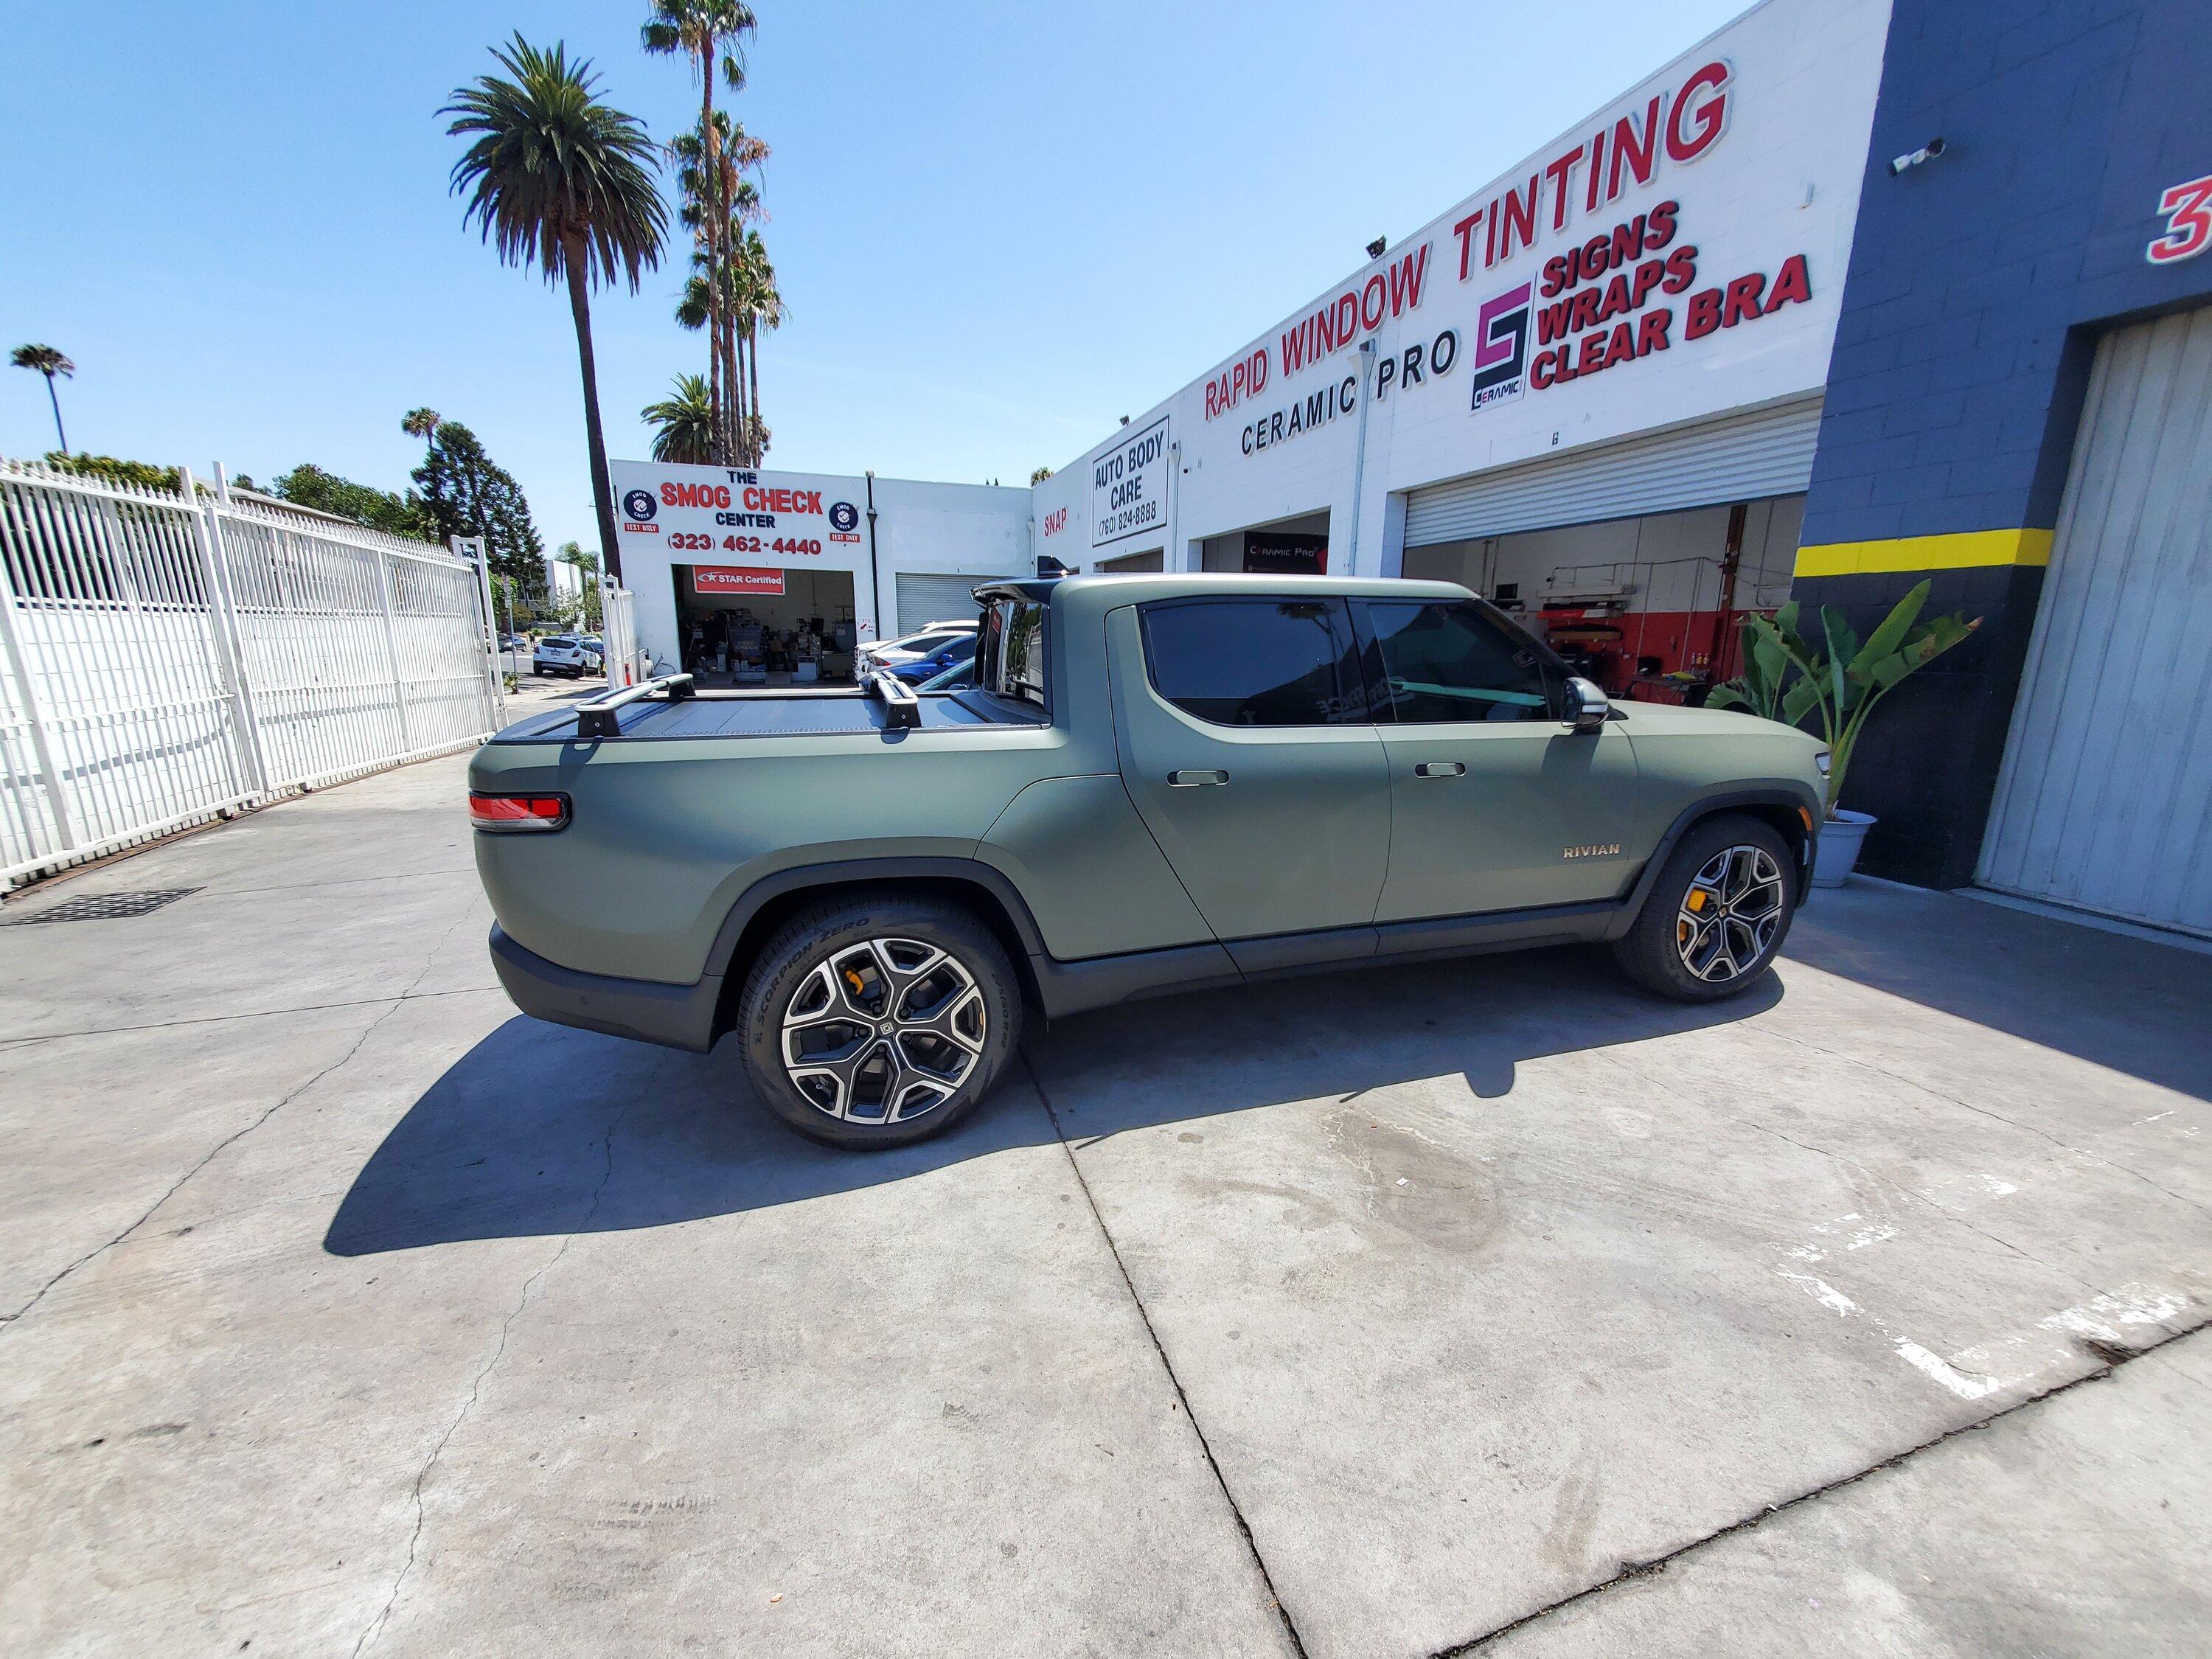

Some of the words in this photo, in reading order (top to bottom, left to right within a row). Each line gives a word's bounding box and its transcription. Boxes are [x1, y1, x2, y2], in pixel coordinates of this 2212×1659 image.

[1204, 348, 1269, 422] RAPID
[1281, 243, 1429, 378] WINDOW
[1453, 60, 1731, 283] TINTING
[1540, 200, 1679, 298] SIGNS
[1537, 245, 1698, 345] WRAPS
[1530, 307, 1673, 391] CLEAR
[1684, 254, 1812, 341] BRA
[1241, 375, 1357, 456] CERAMIC
[1377, 329, 1458, 400] PRO
[1472, 380, 1520, 410] CERAMIC
[1095, 454, 1124, 490] AUTO
[1128, 429, 1164, 473] BODY
[726, 470, 757, 485] THE
[1110, 474, 1142, 510] CARE
[660, 481, 731, 509] SMOG
[742, 487, 824, 515] CHECK
[626, 523, 640, 532] TEST
[642, 524, 657, 532] ONLY
[633, 511, 651, 519] CHECK
[715, 512, 776, 529] CENTER
[1044, 507, 1067, 538] SNAP
[1099, 517, 1116, 537] (760)
[667, 532, 716, 551] (323)
[723, 535, 822, 555] 462-4440
[831, 533, 844, 541] TEST
[845, 534, 859, 542] ONLY
[1249, 546, 1292, 557] CRAMIC
[718, 574, 744, 583] STAR
[745, 576, 782, 585] Certified
[1562, 843, 1621, 858] RIVIAN
[757, 941, 813, 1026] SCORPION
[818, 917, 870, 944] ZERO
